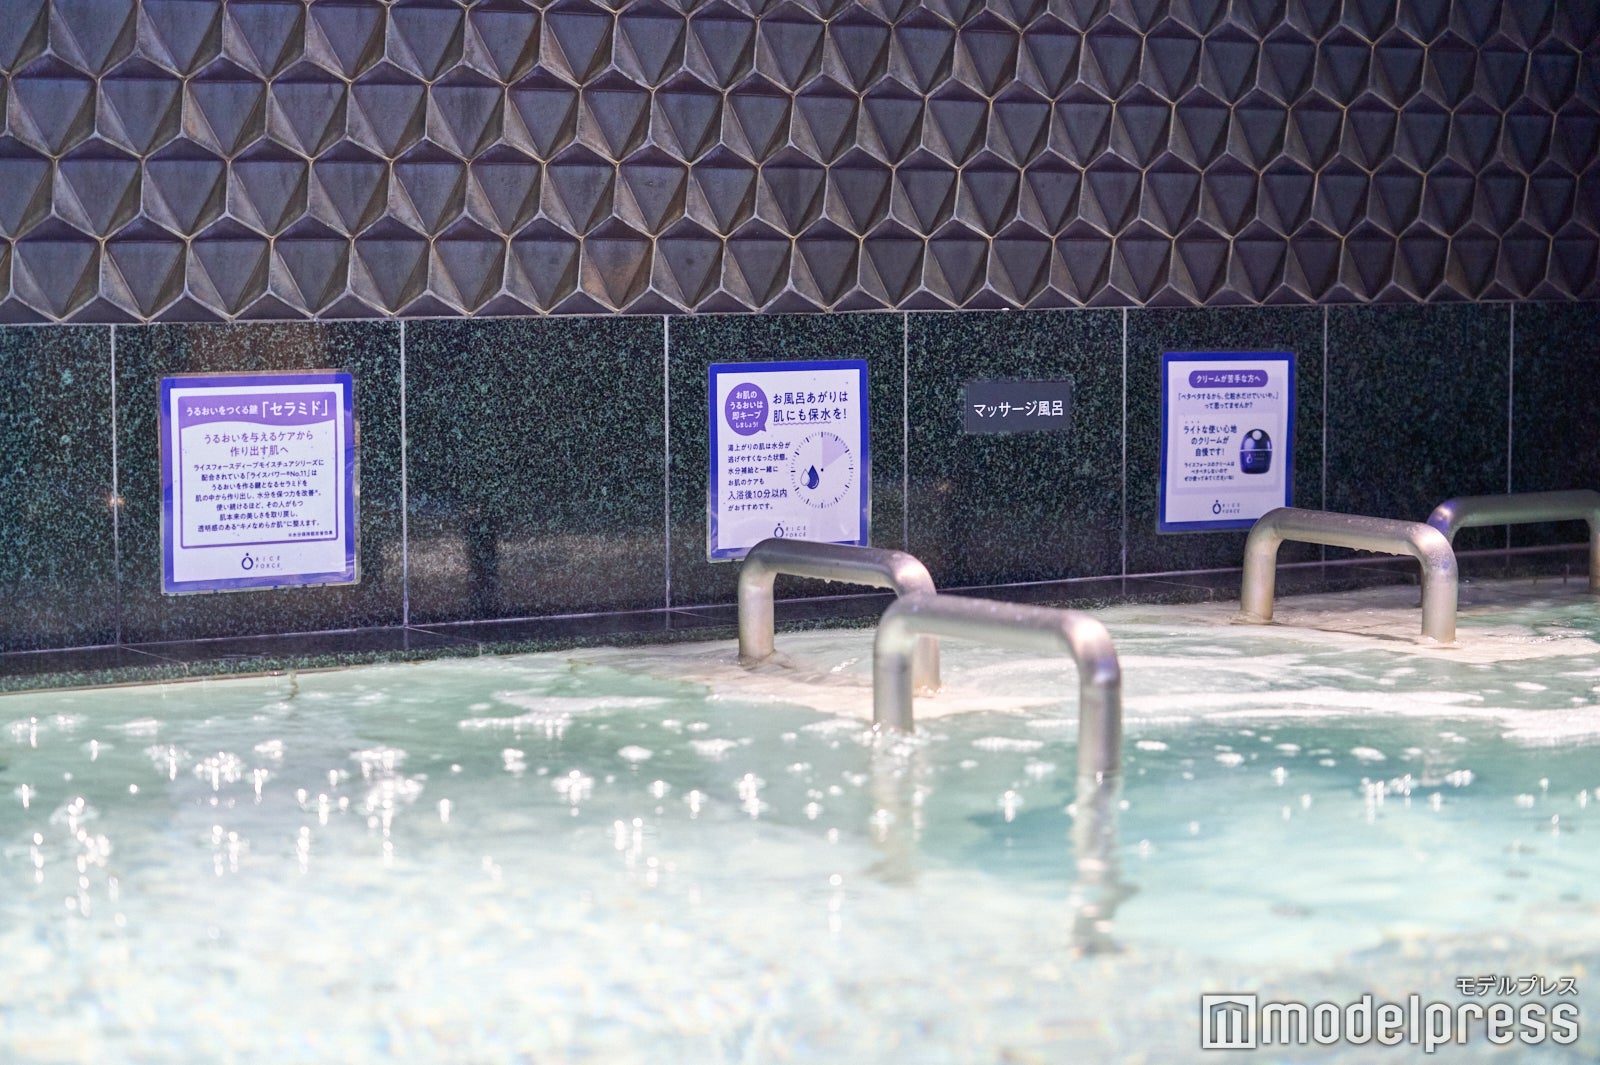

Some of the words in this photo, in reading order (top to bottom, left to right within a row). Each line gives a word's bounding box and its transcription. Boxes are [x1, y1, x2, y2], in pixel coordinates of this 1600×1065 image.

[735, 390, 758, 400] お肌の
[772, 390, 849, 405] お風呂あがりは
[730, 401, 763, 410] うるおいは
[973, 400, 1064, 418] マッサージ風呂
[732, 411, 761, 420] 即キープ
[204, 430, 314, 444] うるおいを与えるケアから
[1191, 436, 1230, 445] のクリームが
[230, 445, 289, 457] 作り出す肌へ
[727, 441, 791, 452] 湯上がりの肌は水分が
[194, 459, 325, 472] ライスフォースディープモイスチュアシリーズに
[727, 466, 779, 475] 水分補給と一緒に
[728, 478, 765, 486] お肌のケアも
[728, 488, 788, 500] 入浴後10分以内
[728, 503, 774, 512] がおすすめです。
